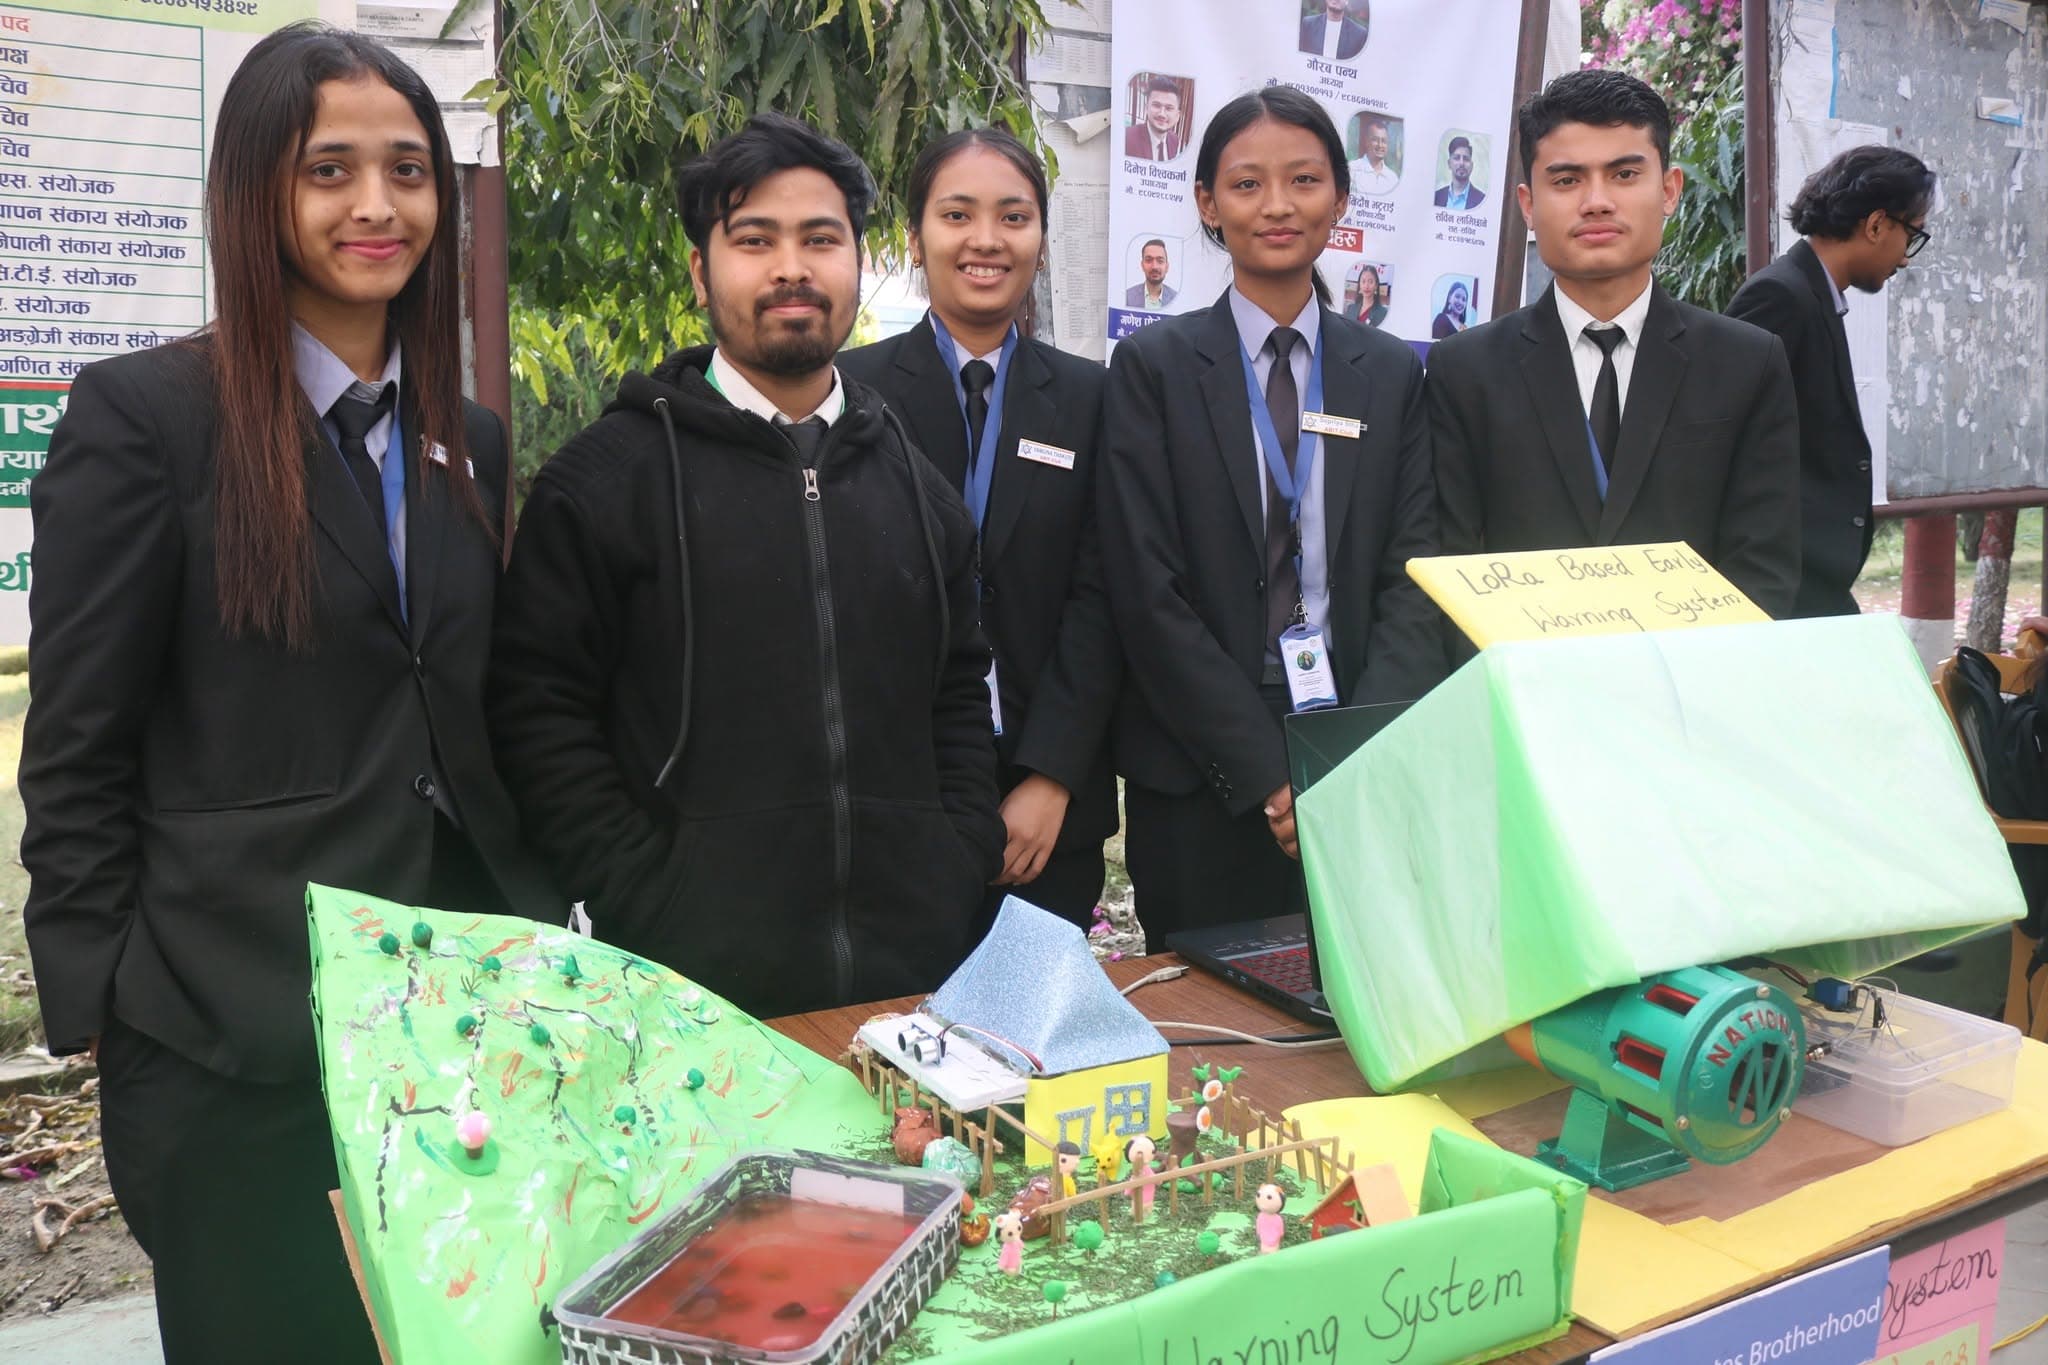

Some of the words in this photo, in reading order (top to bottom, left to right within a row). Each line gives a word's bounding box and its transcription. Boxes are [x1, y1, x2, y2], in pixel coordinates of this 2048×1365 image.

[1, 15, 30, 33] पद
[38, 174, 116, 195] संयोजक
[49, 206, 108, 225] संकाय
[114, 209, 189, 230] संयोजक
[58, 237, 112, 256] संकाय
[118, 239, 187, 260] संयोजक
[63, 267, 138, 287] संयोजक
[15, 295, 91, 315] संयोजक
[68, 329, 119, 347] संकाय
[0, 356, 51, 375] गणित
[1456, 561, 1544, 596] LoRa
[1556, 553, 1634, 581] Based
[1643, 548, 1710, 573] Early
[1521, 604, 1645, 632] Warning
[1655, 588, 1742, 623] System
[1163, 1315, 1340, 1365] rning
[1364, 1256, 1524, 1363] System
[1750, 1296, 1881, 1364] Brotherhood
